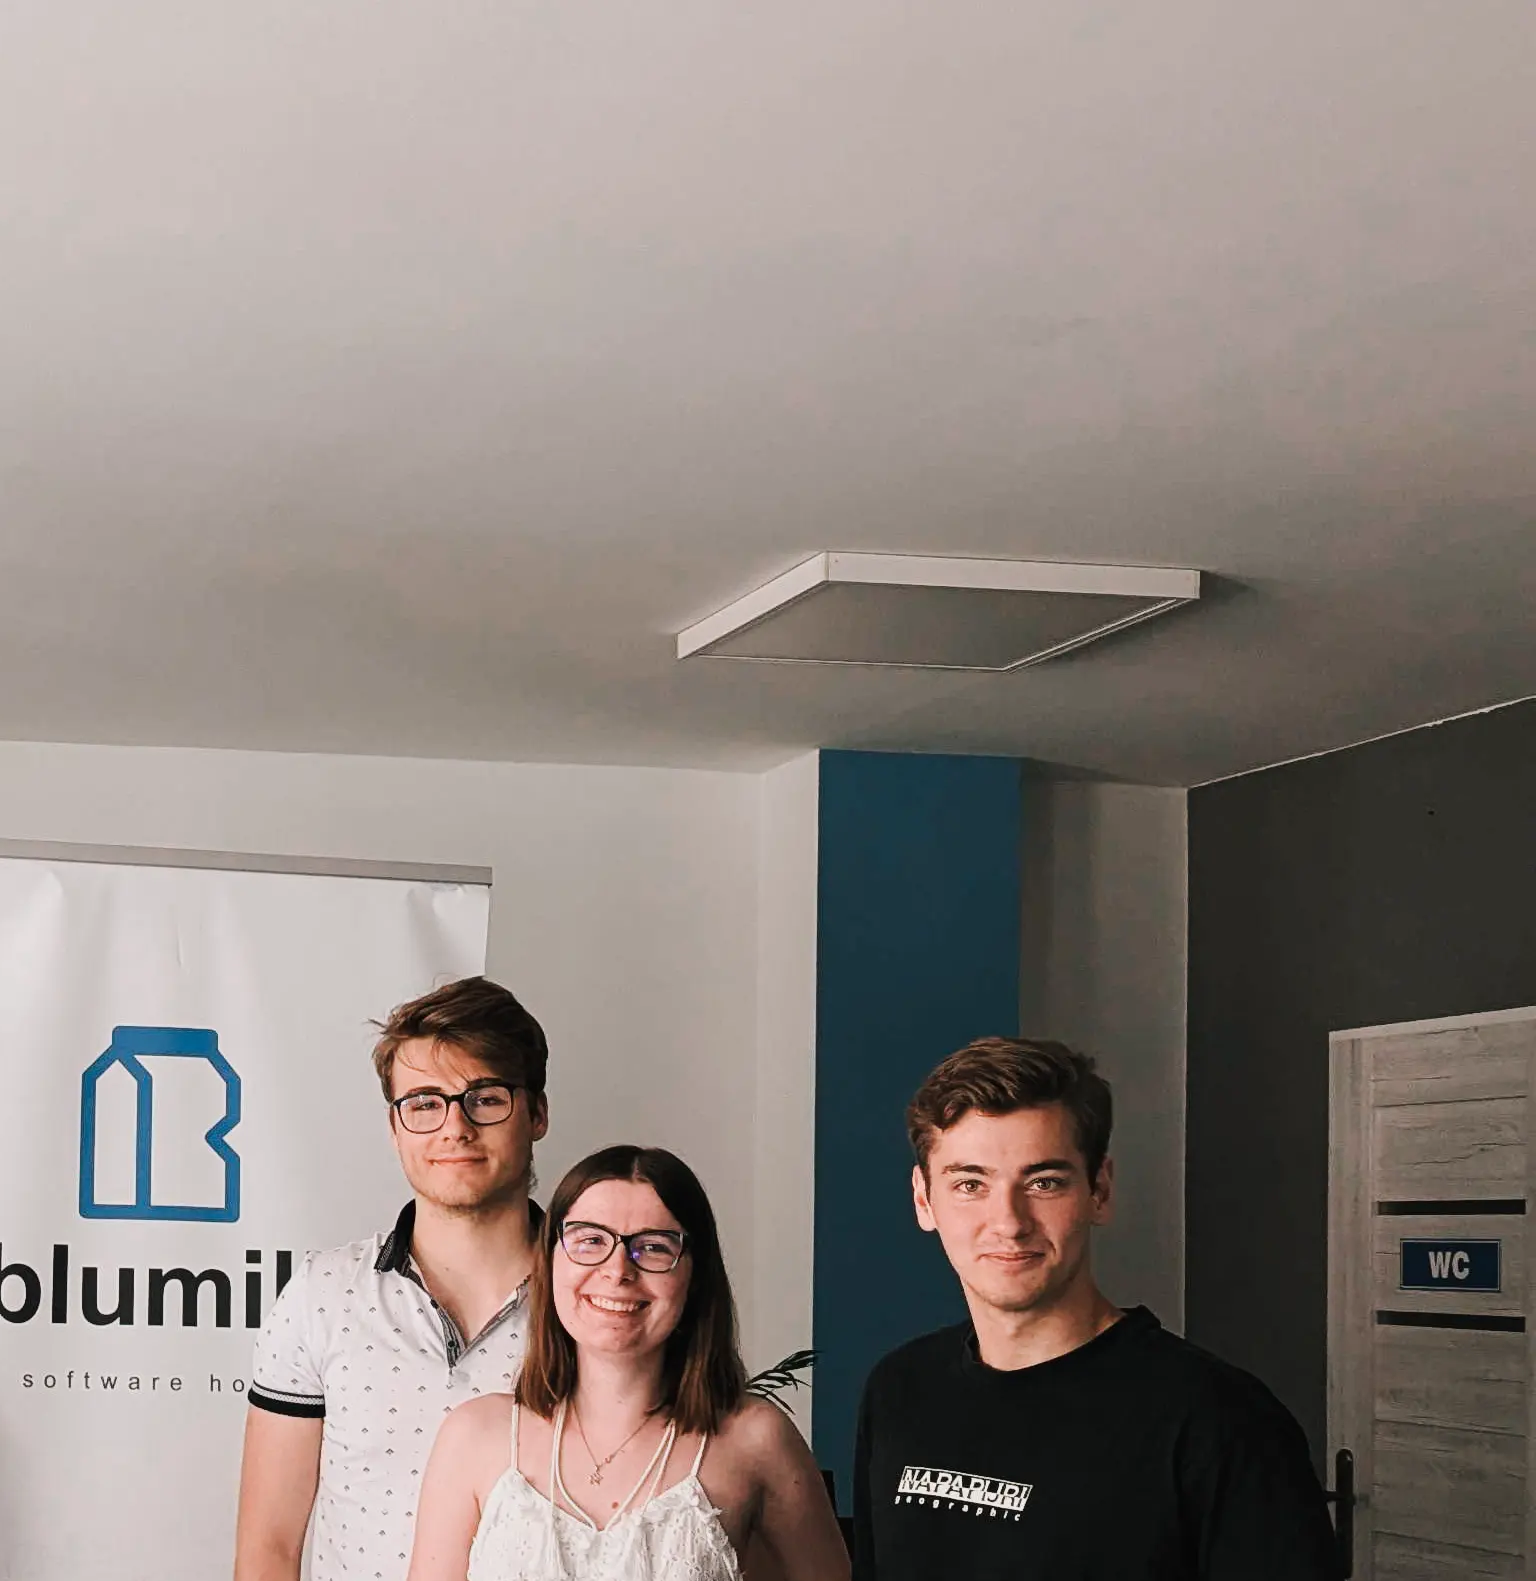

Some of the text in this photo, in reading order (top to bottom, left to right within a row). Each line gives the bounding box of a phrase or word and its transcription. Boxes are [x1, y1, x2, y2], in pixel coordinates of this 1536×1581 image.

[1428, 1251, 1470, 1280] WC
[23, 1370, 182, 1391] software
[900, 1468, 1030, 1509] NAPAPIJRI
[894, 1494, 1021, 1522] geographic
